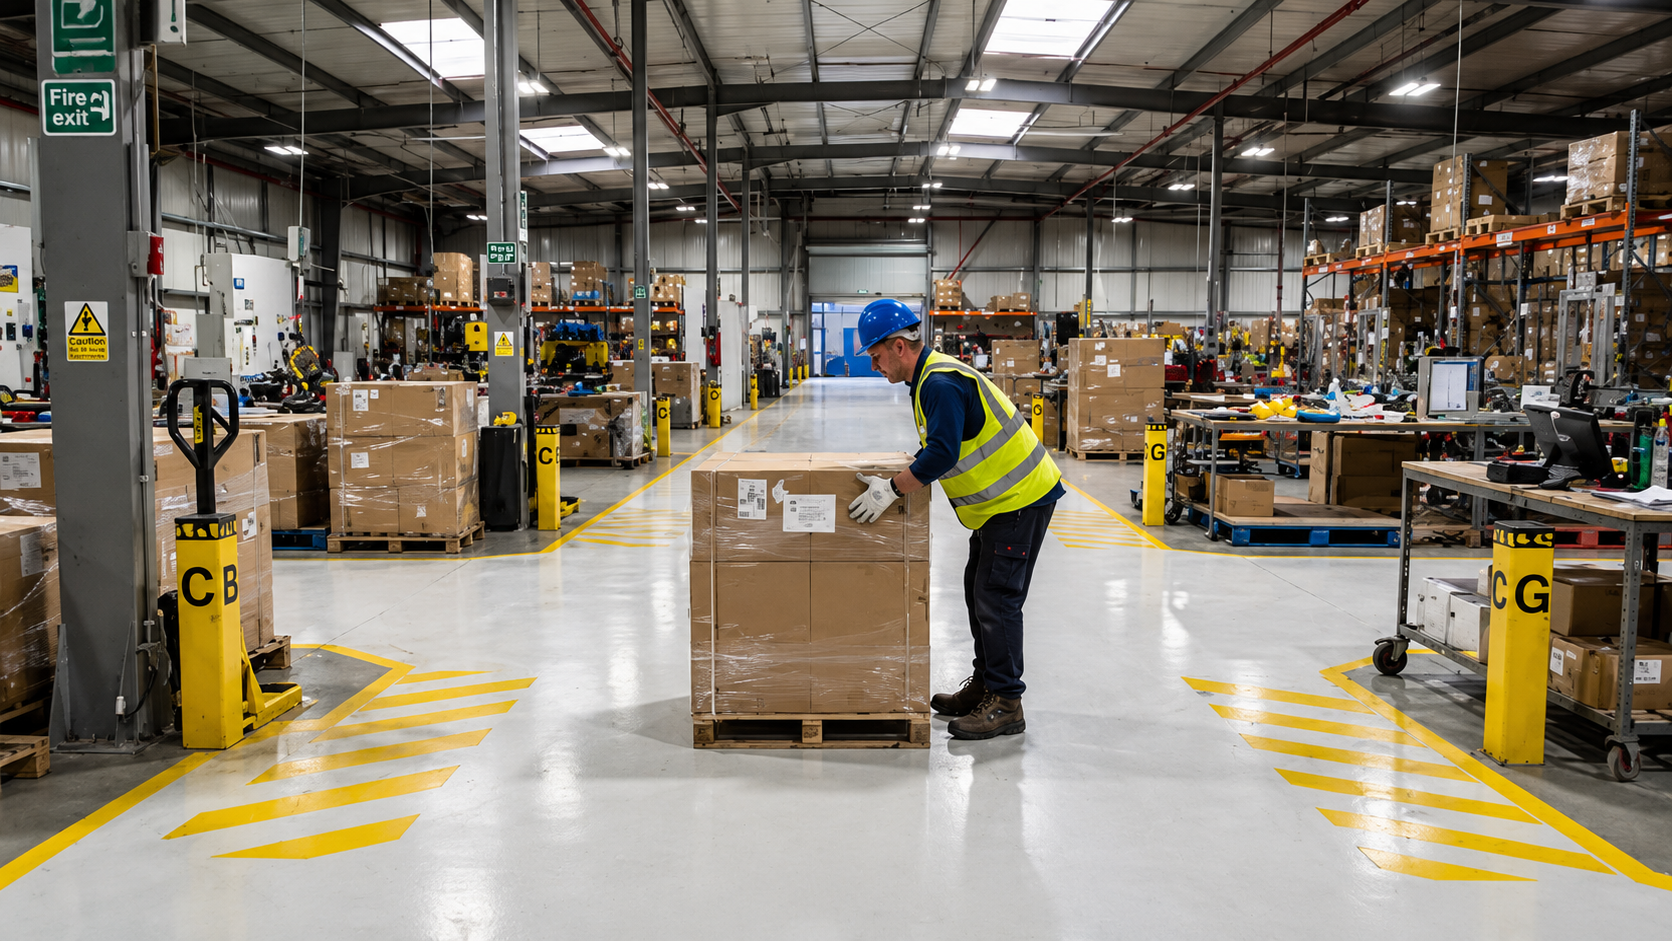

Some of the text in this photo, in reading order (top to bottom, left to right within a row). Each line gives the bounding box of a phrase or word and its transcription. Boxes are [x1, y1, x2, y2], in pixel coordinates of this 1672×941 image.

[50, 88, 87, 106] Fire
[52, 108, 90, 126] exit
[538, 446, 553, 465] C
[1151, 443, 1165, 461] G
[181, 566, 215, 607] C
[223, 564, 238, 606] B
[1493, 570, 1507, 610] C
[1515, 574, 1549, 614] G
